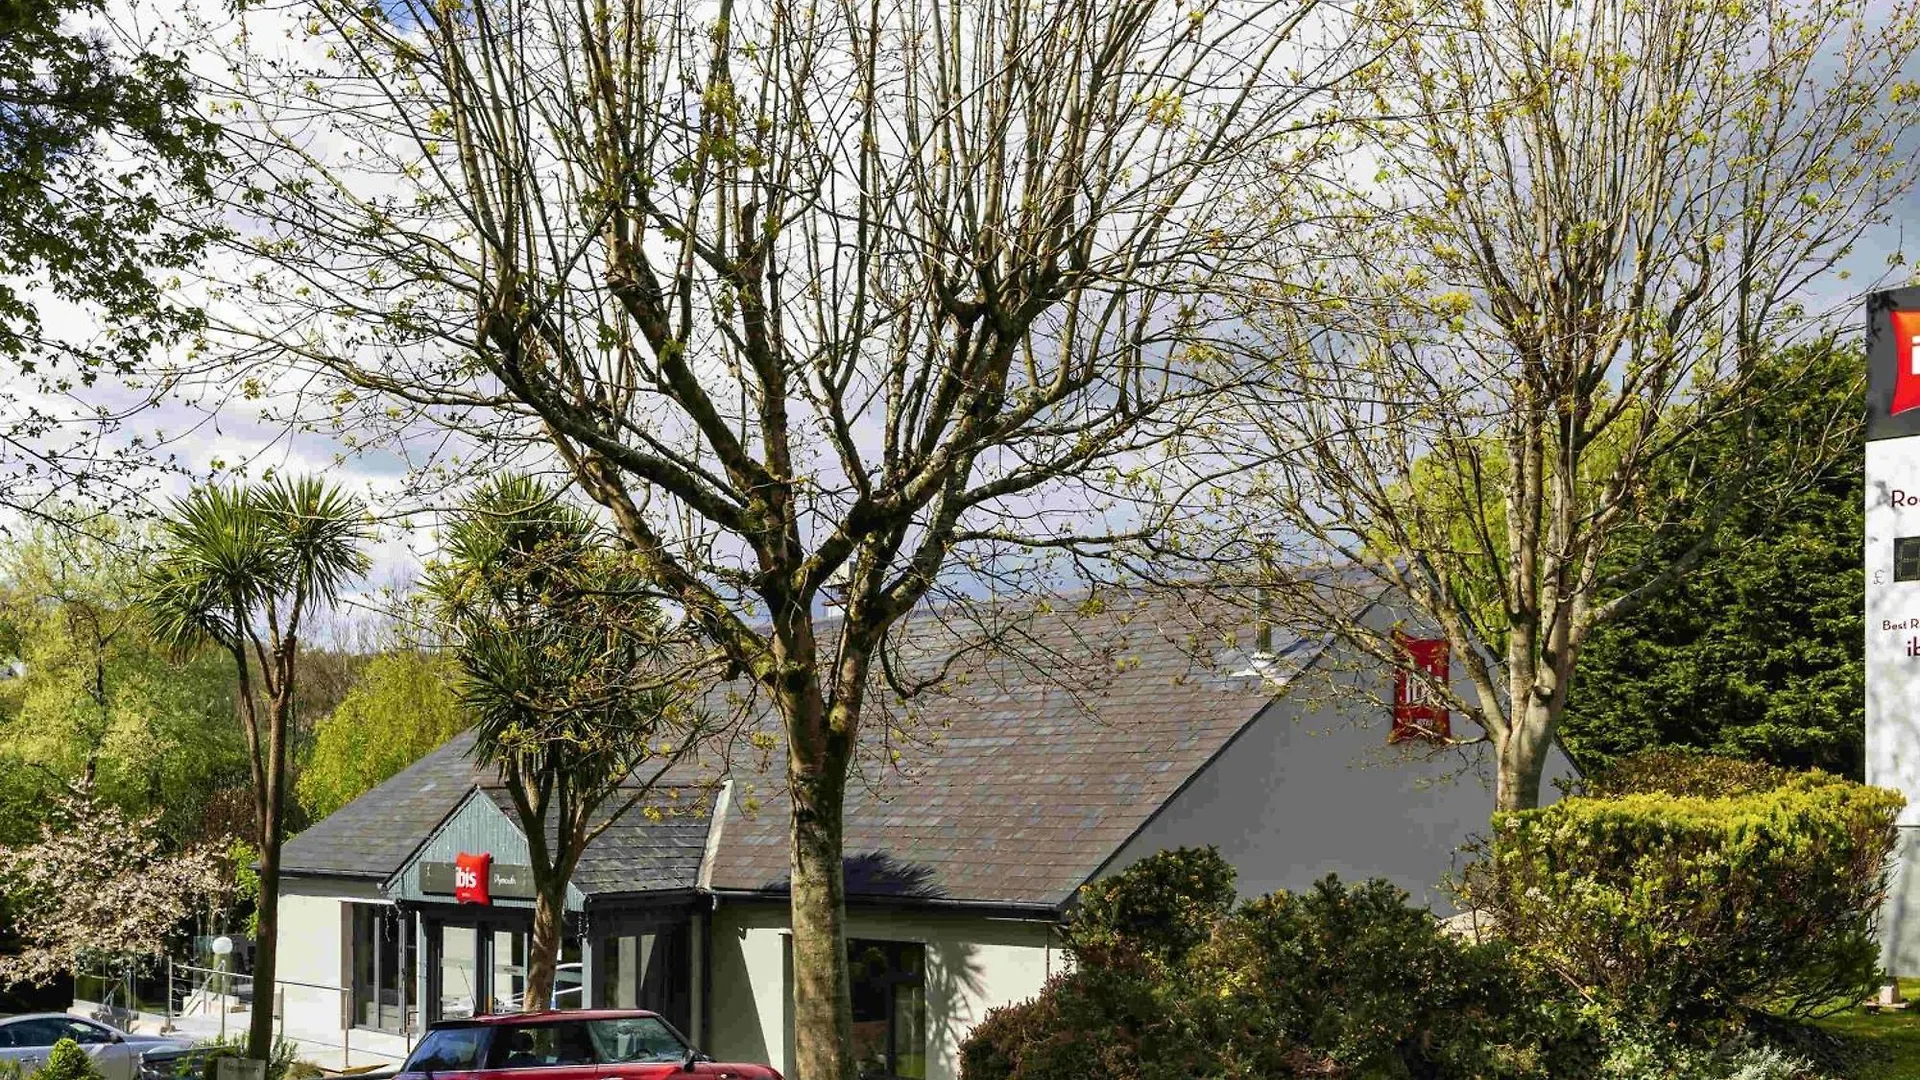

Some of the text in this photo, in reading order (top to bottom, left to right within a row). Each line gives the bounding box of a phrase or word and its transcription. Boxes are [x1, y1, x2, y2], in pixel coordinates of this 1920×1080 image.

[1891, 490, 1920, 507] Ro
[1883, 620, 1906, 631] Best
[455, 867, 476, 888] ibis
